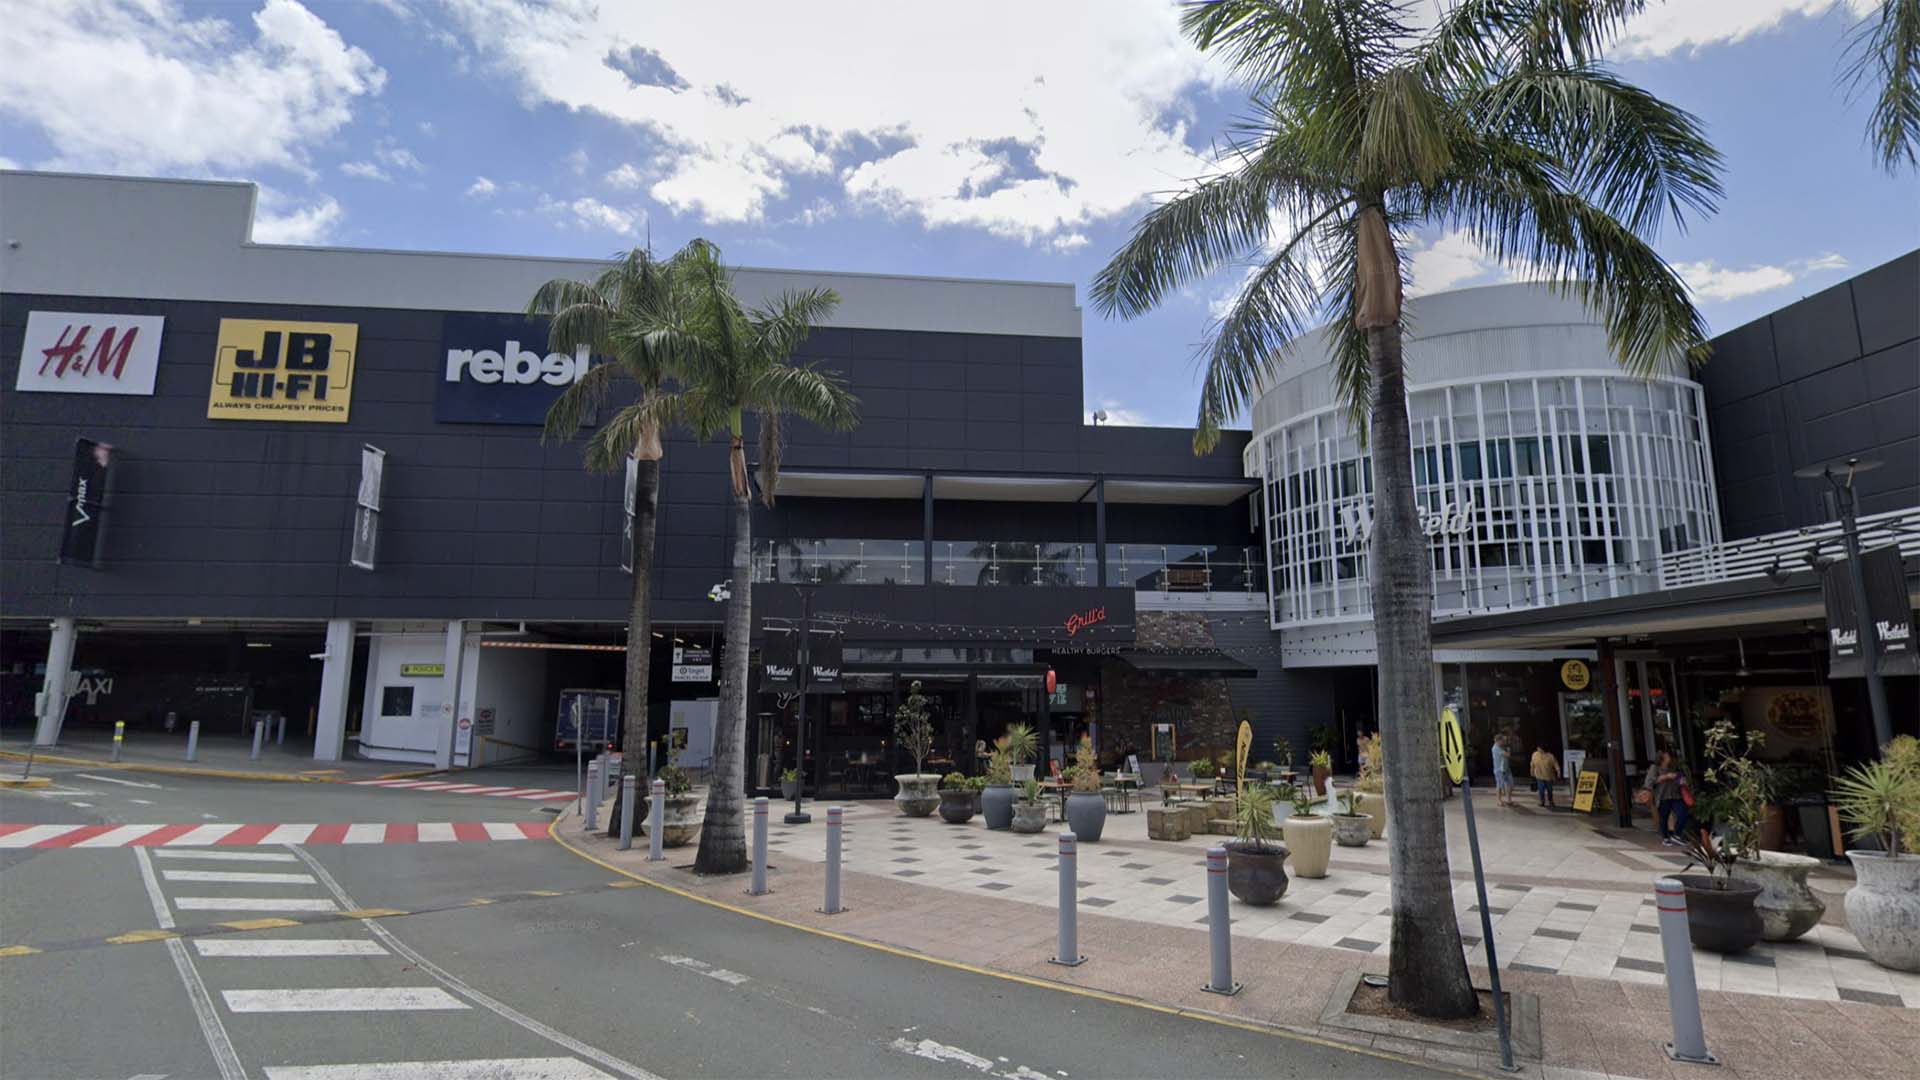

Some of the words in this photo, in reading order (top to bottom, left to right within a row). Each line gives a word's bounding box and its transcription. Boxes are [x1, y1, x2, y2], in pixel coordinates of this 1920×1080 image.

[38, 324, 140, 381] H&M
[235, 330, 332, 371] JB
[446, 340, 591, 386] rebel
[213, 402, 251, 410] ALWAYS
[254, 402, 306, 411] CHEAPEST
[308, 403, 345, 412] PRICES
[1064, 605, 1106, 637] Grill'd
[1051, 647, 1084, 655] HEALTHY
[1086, 646, 1121, 655] BURGERS
[78, 677, 114, 695] AXI
